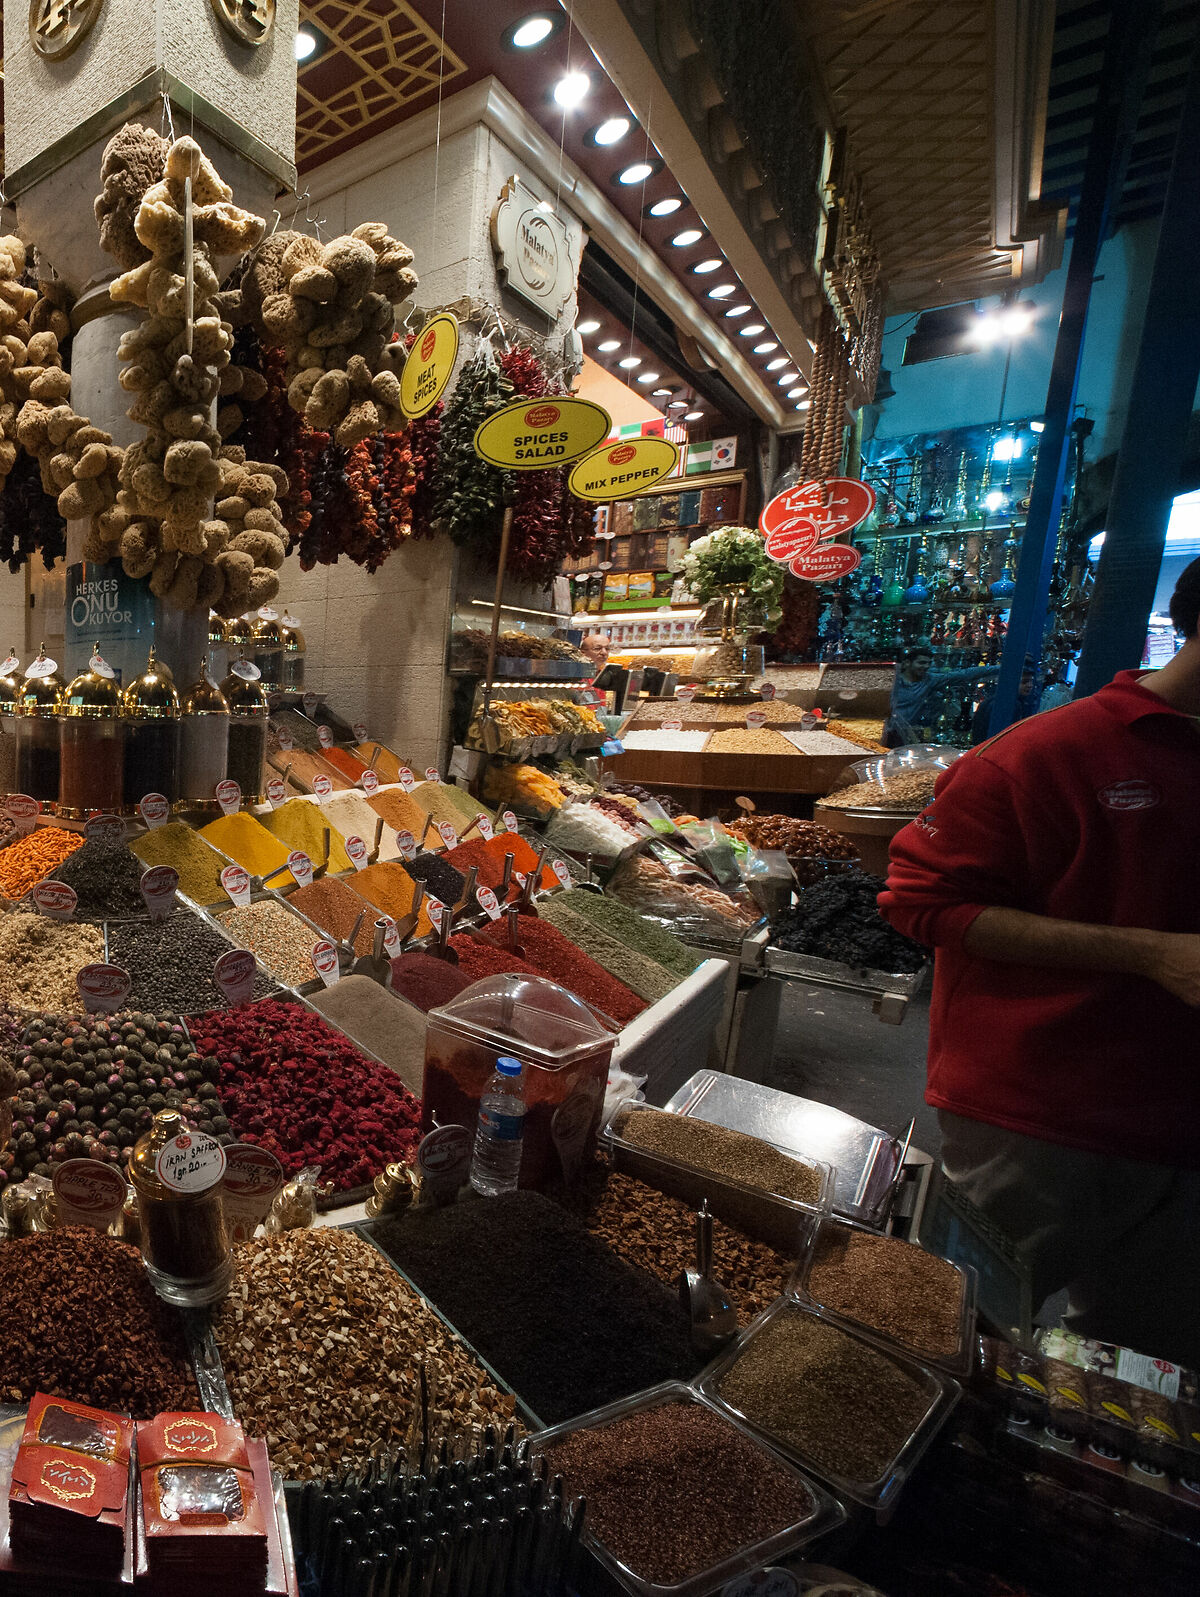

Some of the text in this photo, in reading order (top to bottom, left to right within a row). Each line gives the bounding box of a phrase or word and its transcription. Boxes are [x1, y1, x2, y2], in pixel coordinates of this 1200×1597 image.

[521, 223, 555, 266] Malatya
[417, 363, 436, 387] MEAT
[413, 377, 437, 405] SPICES
[513, 431, 569, 447] SPICES
[515, 445, 565, 459] SALAD
[584, 466, 660, 491] MIX PEPPER
[798, 554, 851, 565] Malatya
[75, 578, 118, 596] HERKES
[227, 1159, 260, 1174] RANGE
[63, 1174, 122, 1194] APPLE TEA
